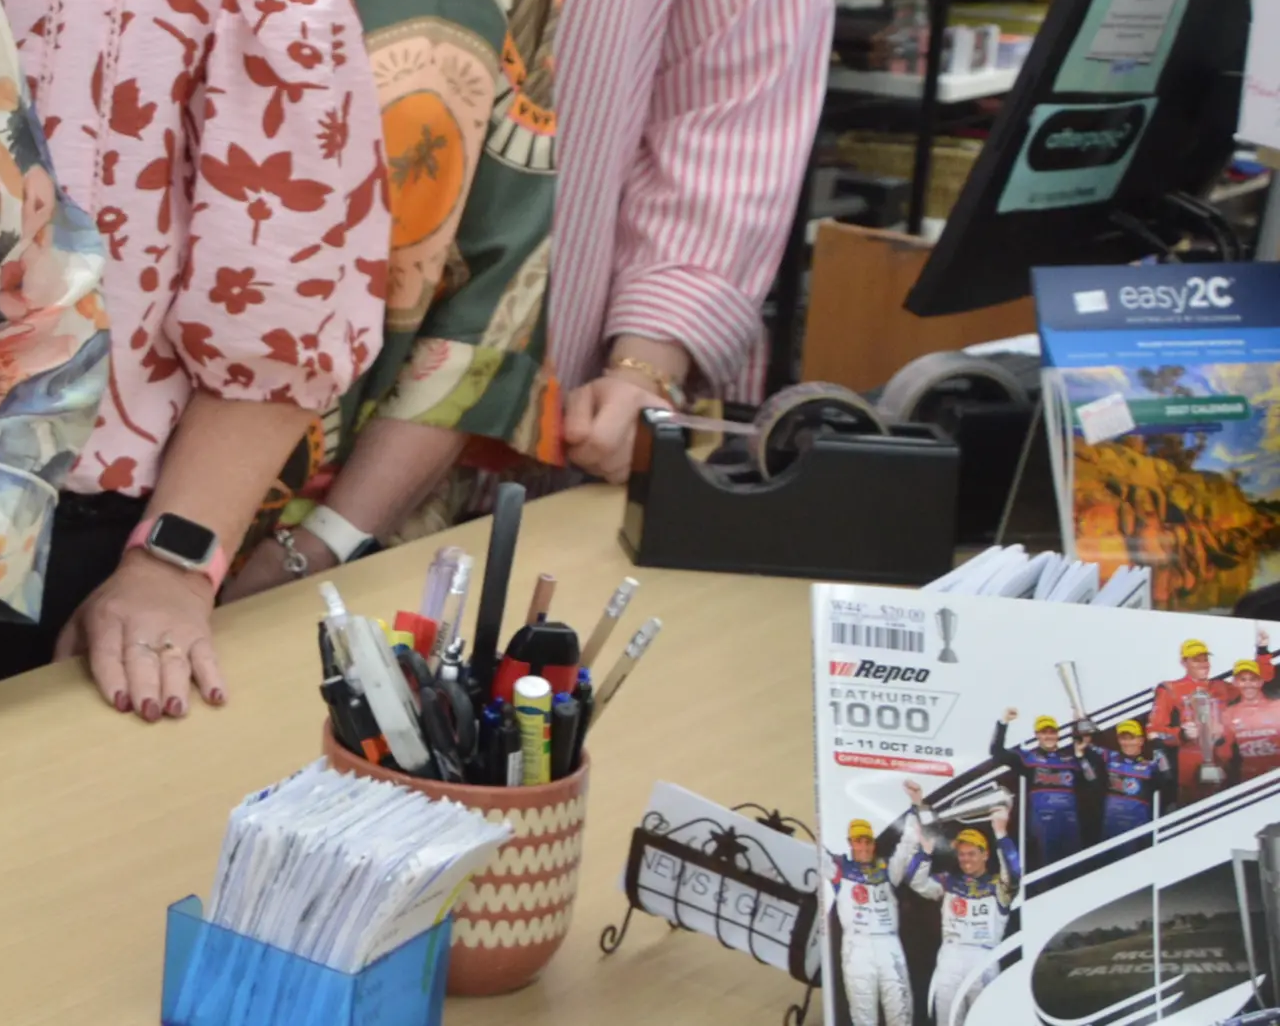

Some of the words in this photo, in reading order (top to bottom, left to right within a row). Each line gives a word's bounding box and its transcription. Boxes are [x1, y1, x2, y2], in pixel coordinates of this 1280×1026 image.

[1119, 276, 1234, 314] easy2C
[854, 659, 930, 683] Repco
[830, 687, 940, 706] BATHURST
[829, 701, 930, 733] 1000
[879, 741, 909, 753] OCT
[642, 850, 711, 896] NEWS
[972, 905, 990, 917] LG
